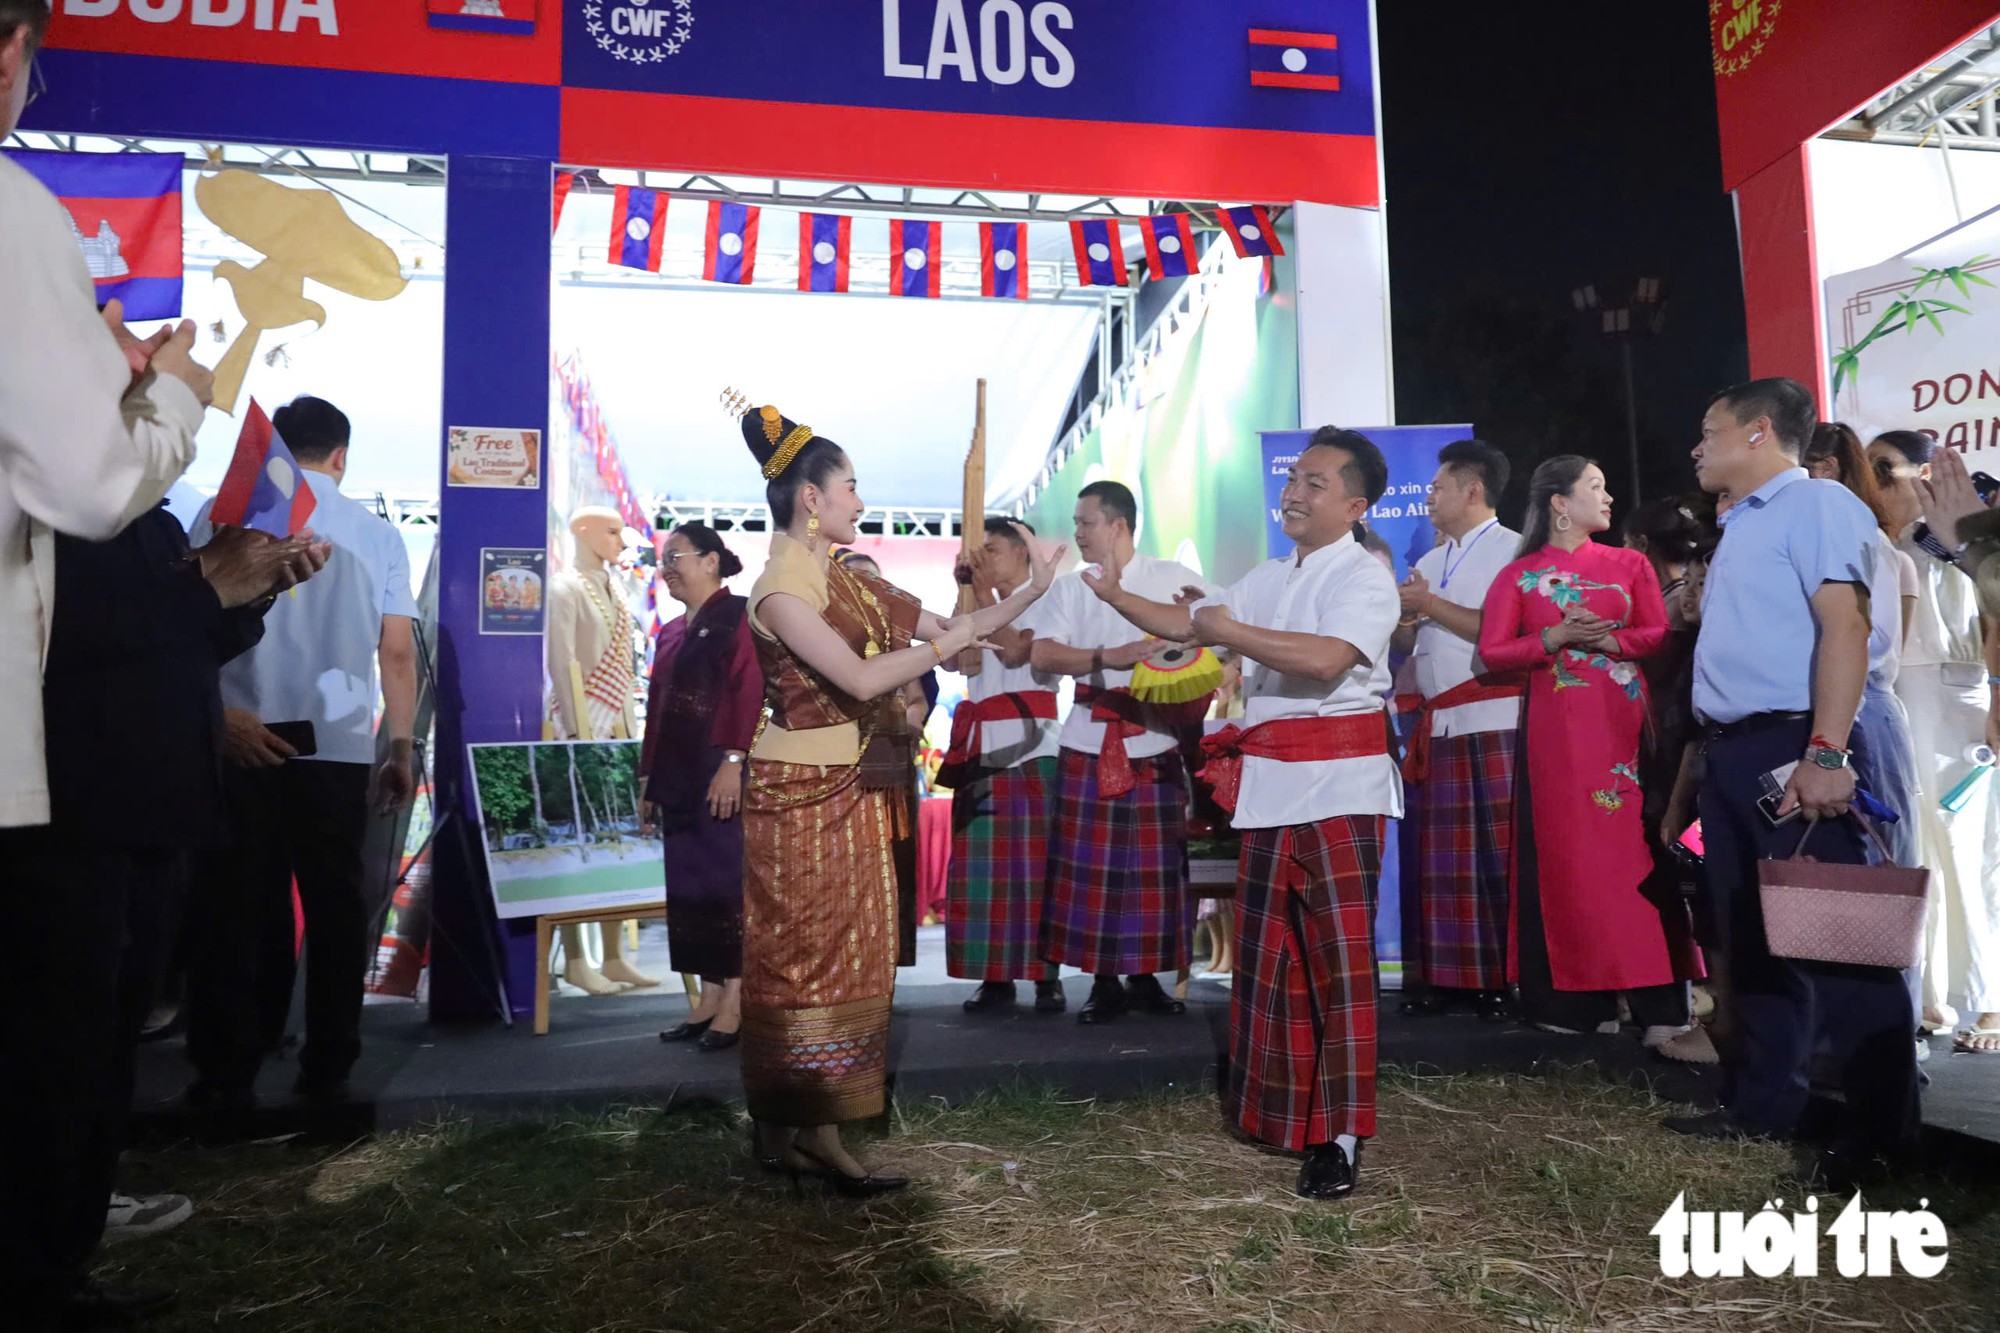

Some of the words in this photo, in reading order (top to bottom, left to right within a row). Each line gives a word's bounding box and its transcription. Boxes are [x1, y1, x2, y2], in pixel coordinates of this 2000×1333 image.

[611, 7, 671, 37] CWF
[883, 0, 1075, 88] LAOS
[473, 434, 513, 451] Free
[463, 457, 480, 467] Lao
[481, 457, 526, 468] Traditional
[473, 466, 513, 476] Costume
[1400, 481, 1422, 495] xin
[1372, 504, 1402, 518] Lao
